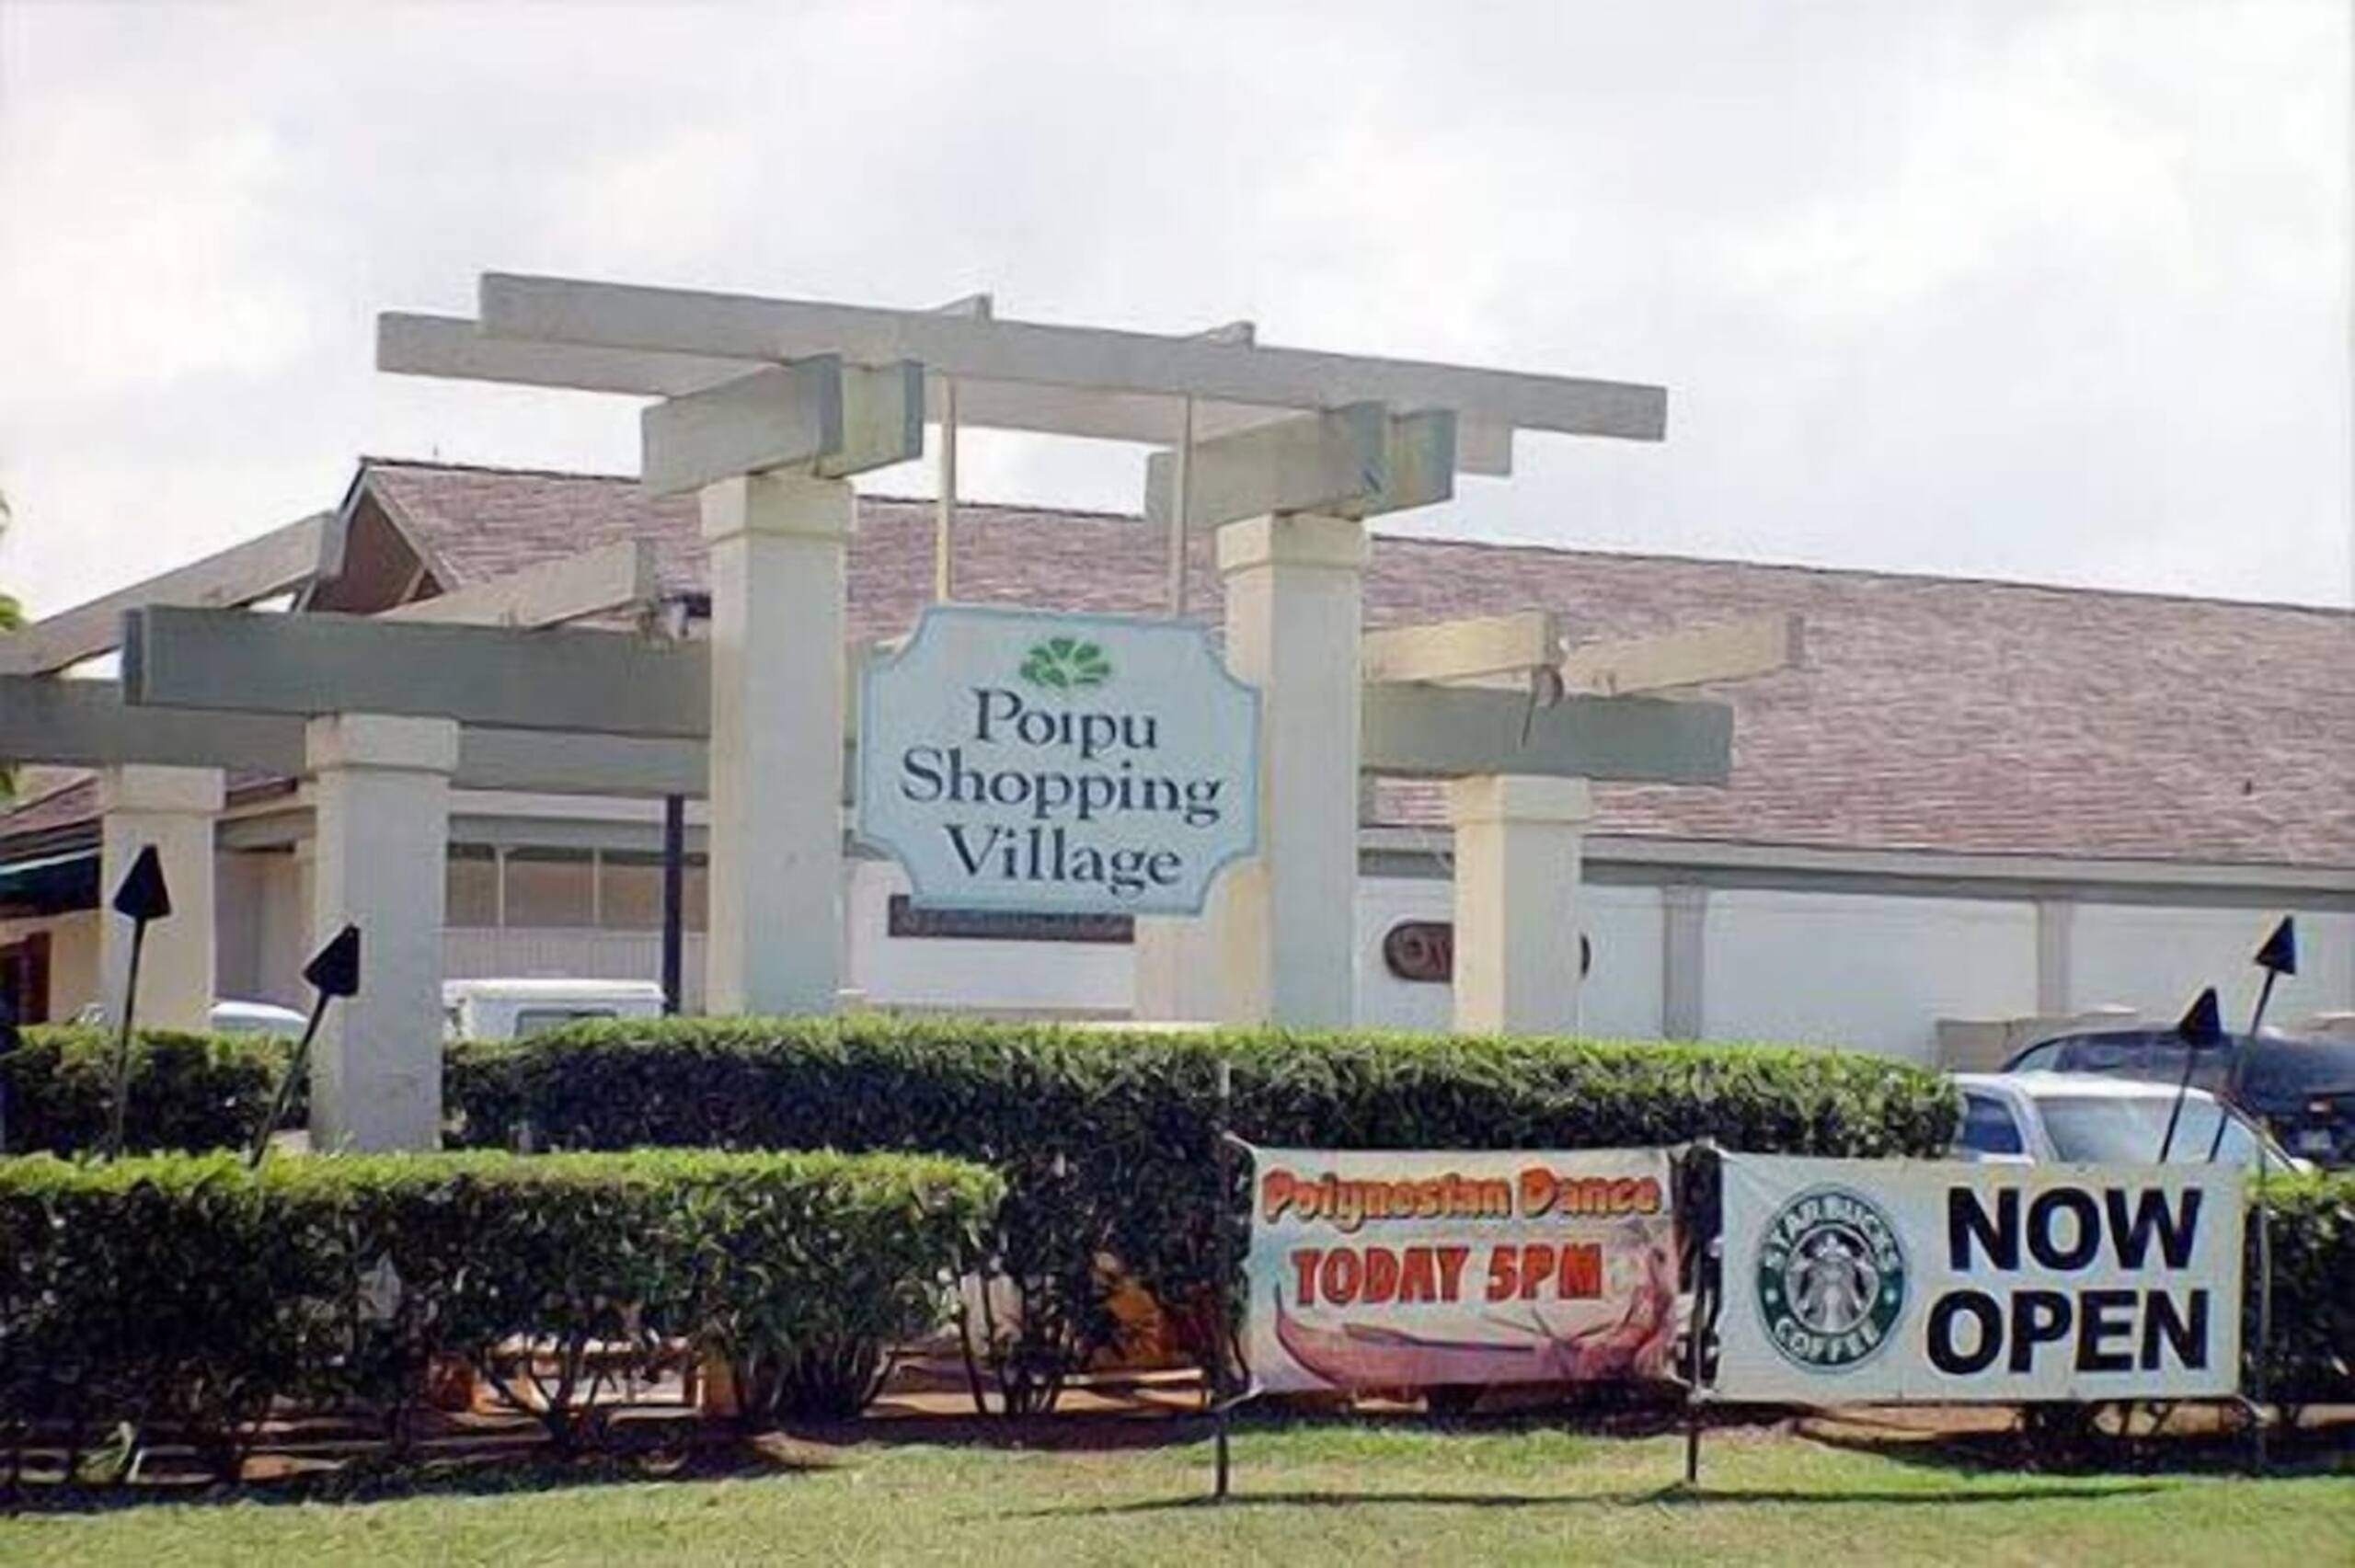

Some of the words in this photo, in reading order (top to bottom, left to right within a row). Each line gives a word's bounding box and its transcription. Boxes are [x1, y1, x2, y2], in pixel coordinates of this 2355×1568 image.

[971, 687, 1158, 760] Poipu
[900, 746, 1225, 827] Shopping
[945, 823, 1184, 898] Village
[1260, 1166, 1513, 1233] Polynesian
[1517, 1161, 1661, 1216] Dance
[1947, 1185, 2204, 1272] NOW
[1290, 1243, 1471, 1307] TODAY
[1484, 1242, 1603, 1302] 5PM
[1775, 1317, 1879, 1362] COFFEE
[1925, 1288, 2209, 1376] OPEN
